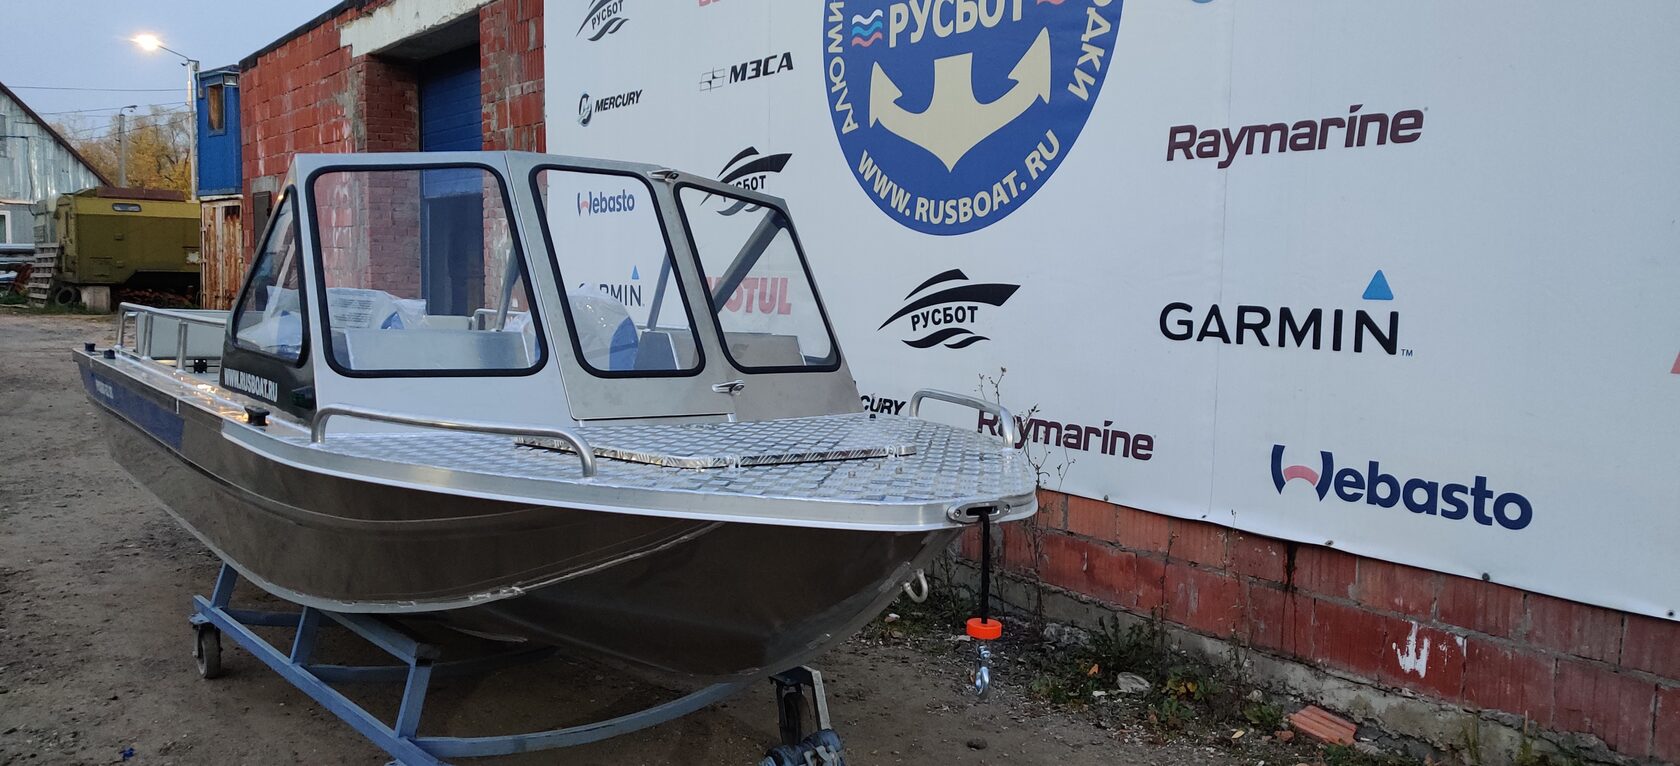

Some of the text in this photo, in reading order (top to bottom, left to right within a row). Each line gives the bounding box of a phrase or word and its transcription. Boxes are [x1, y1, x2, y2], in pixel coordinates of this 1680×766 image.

[591, 0, 623, 30] РУСБОТ
[594, 89, 643, 113] MERCURY
[1166, 104, 1425, 169] Raymarine
[577, 189, 635, 216] Webasto
[910, 305, 979, 332] РУСБОТ
[1159, 302, 1399, 355] GARMIN
[861, 395, 906, 416] CURY
[977, 407, 1154, 461] Rymarine
[1271, 444, 1533, 530] Webasto
